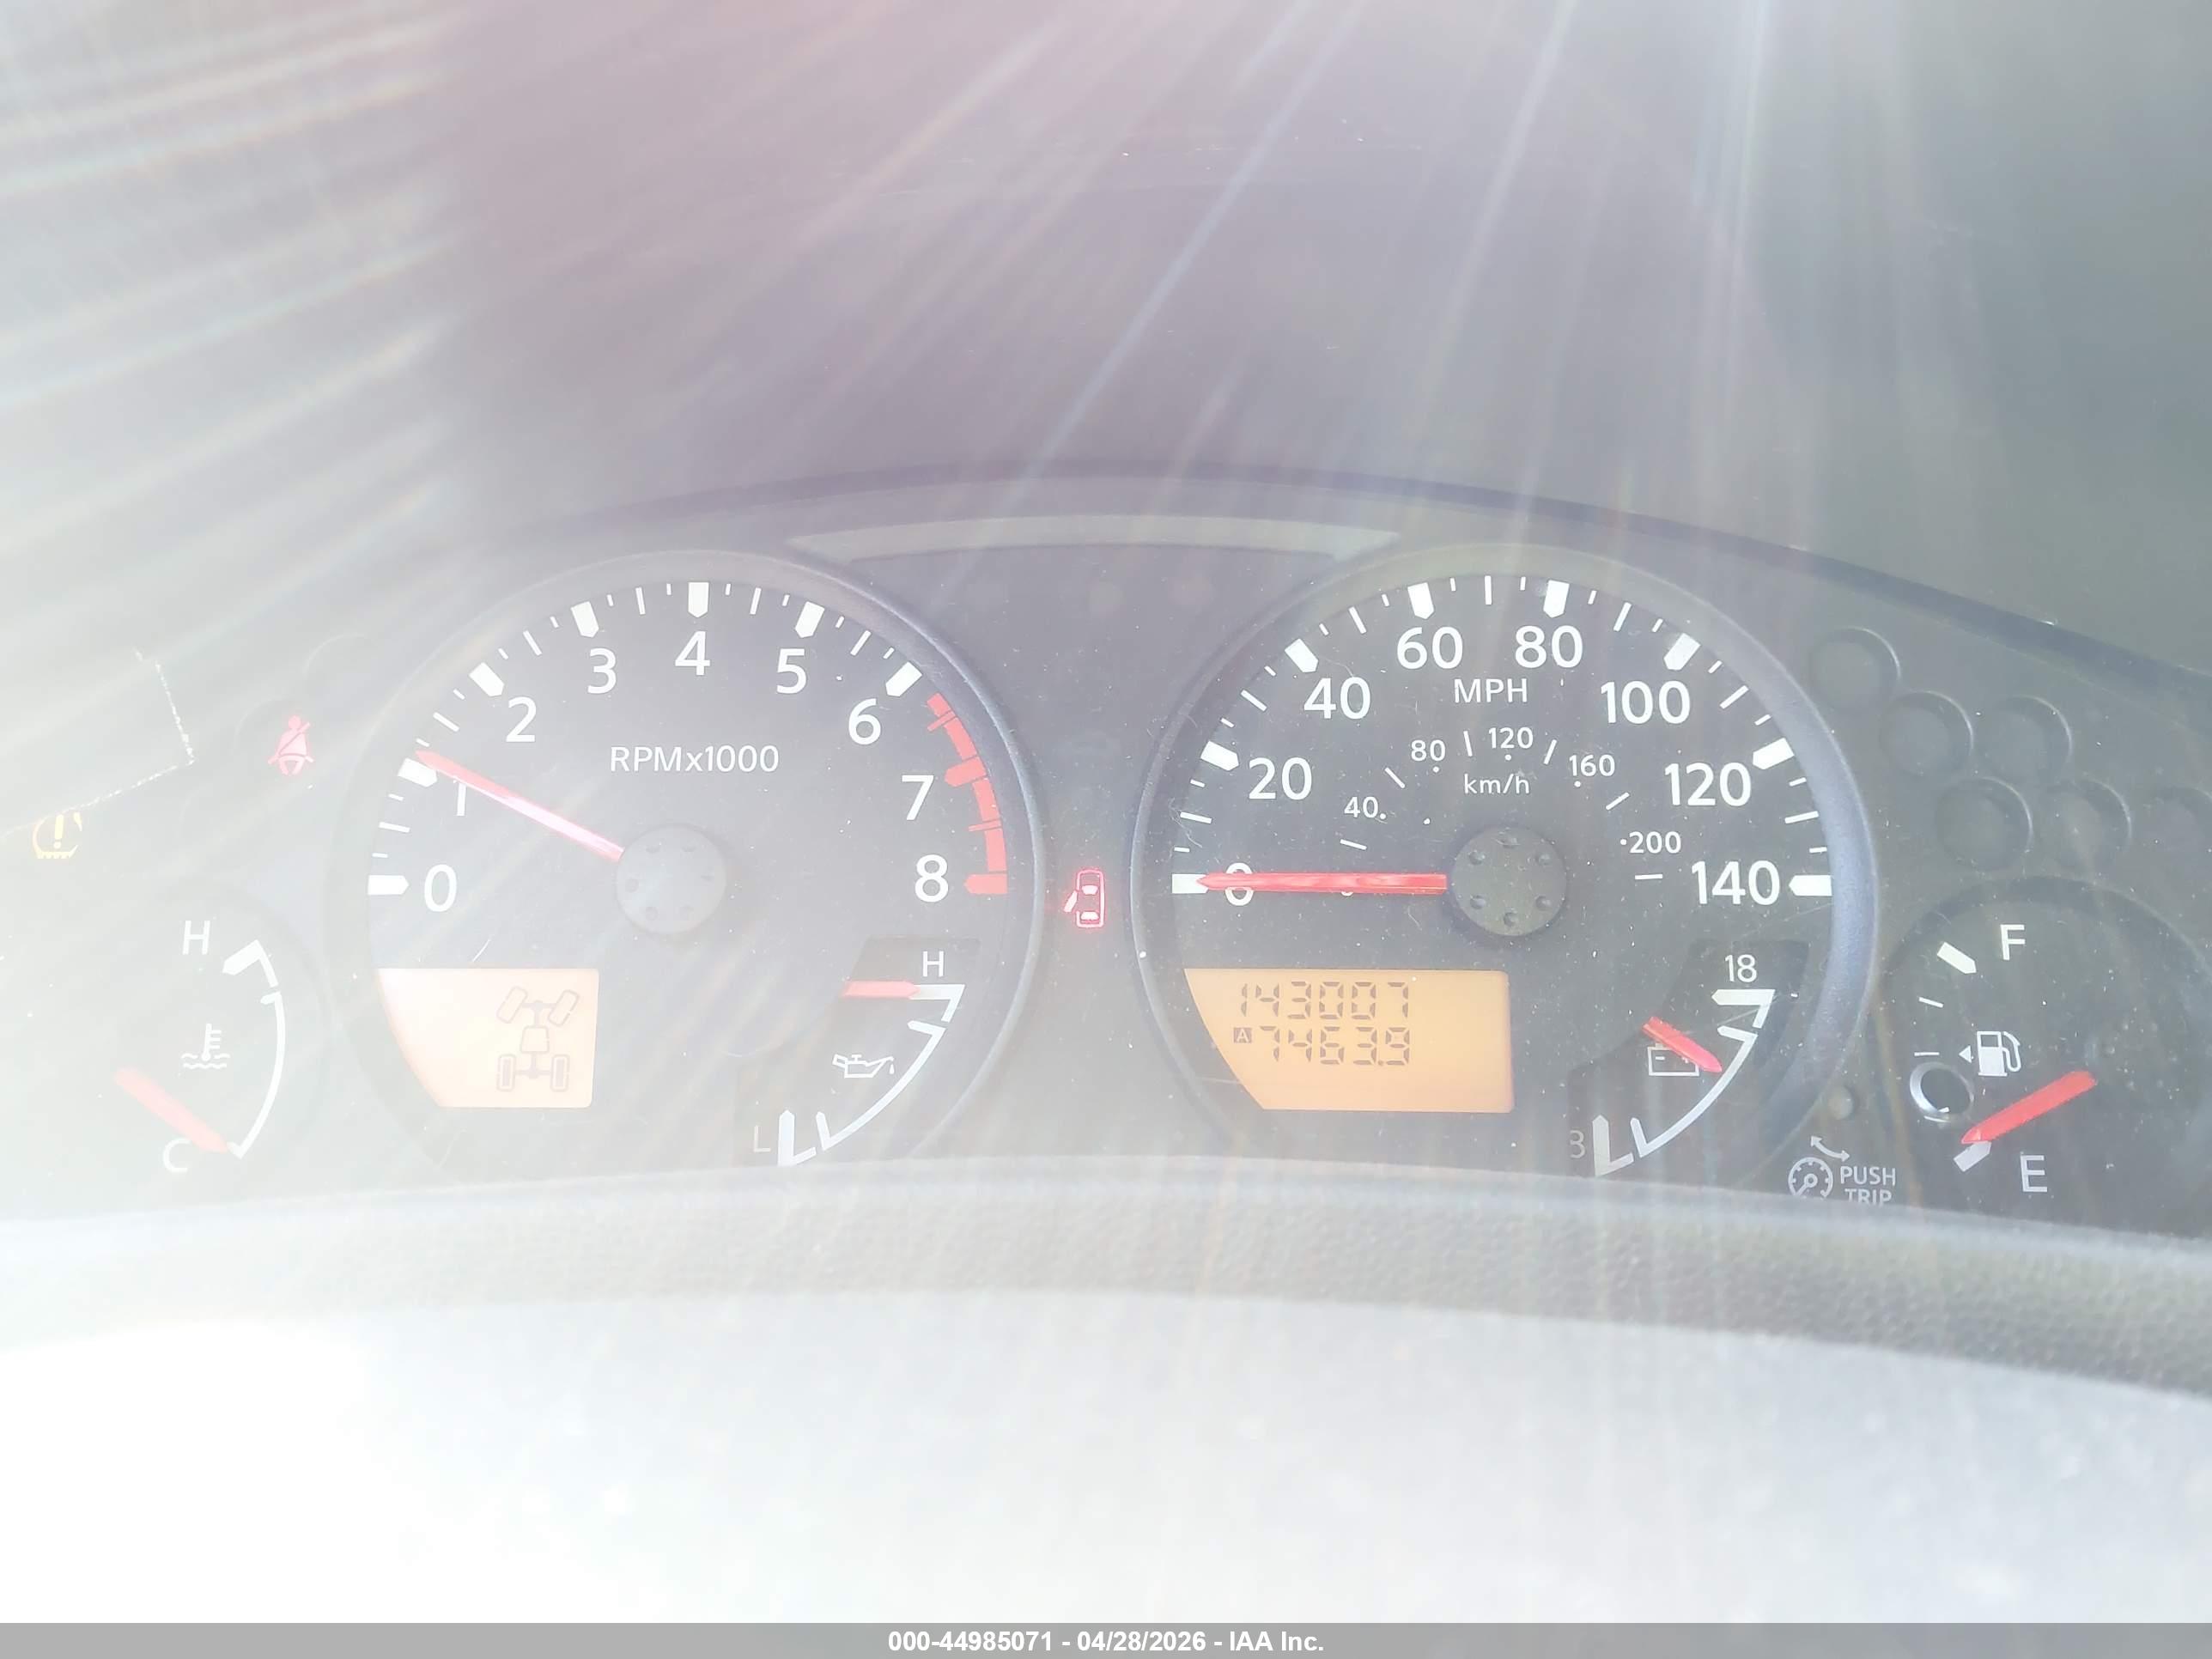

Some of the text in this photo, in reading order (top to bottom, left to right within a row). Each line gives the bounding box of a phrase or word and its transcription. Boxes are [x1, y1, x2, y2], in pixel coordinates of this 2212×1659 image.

[675, 630, 711, 676] 4
[1396, 626, 1463, 670] 60
[1515, 625, 1583, 669] 80
[587, 647, 617, 694] 3
[776, 648, 806, 694] 5
[1304, 676, 1370, 720] 40
[1454, 678, 1528, 703] MPH
[1601, 680, 1691, 724] 100
[506, 696, 537, 743] 2
[848, 698, 881, 745] 6
[1488, 726, 1534, 749] 120
[611, 744, 779, 772] RPMx1000
[1411, 739, 1446, 762] 80
[1569, 754, 1615, 777] 160
[902, 775, 934, 821] 7
[1249, 757, 1312, 800] 20
[1464, 773, 1529, 794] km/h
[1664, 762, 1752, 806] 120
[1344, 796, 1379, 818] 40
[1629, 830, 1681, 854] 200
[423, 864, 457, 913] 0
[915, 854, 949, 902] 8
[1691, 860, 1780, 906] 140
[182, 920, 210, 956] H
[2000, 924, 2026, 961] F
[922, 951, 945, 977] H
[1724, 954, 1757, 983] 18
[1240, 981, 1409, 1021] 143007
[1259, 1025, 1410, 1066] 7463.9
[162, 1139, 190, 1173] C
[753, 1125, 771, 1153] L
[1839, 1165, 1896, 1187] PUSH
[2020, 1155, 2048, 1193] E
[1844, 1188, 1892, 1207] TRIP
